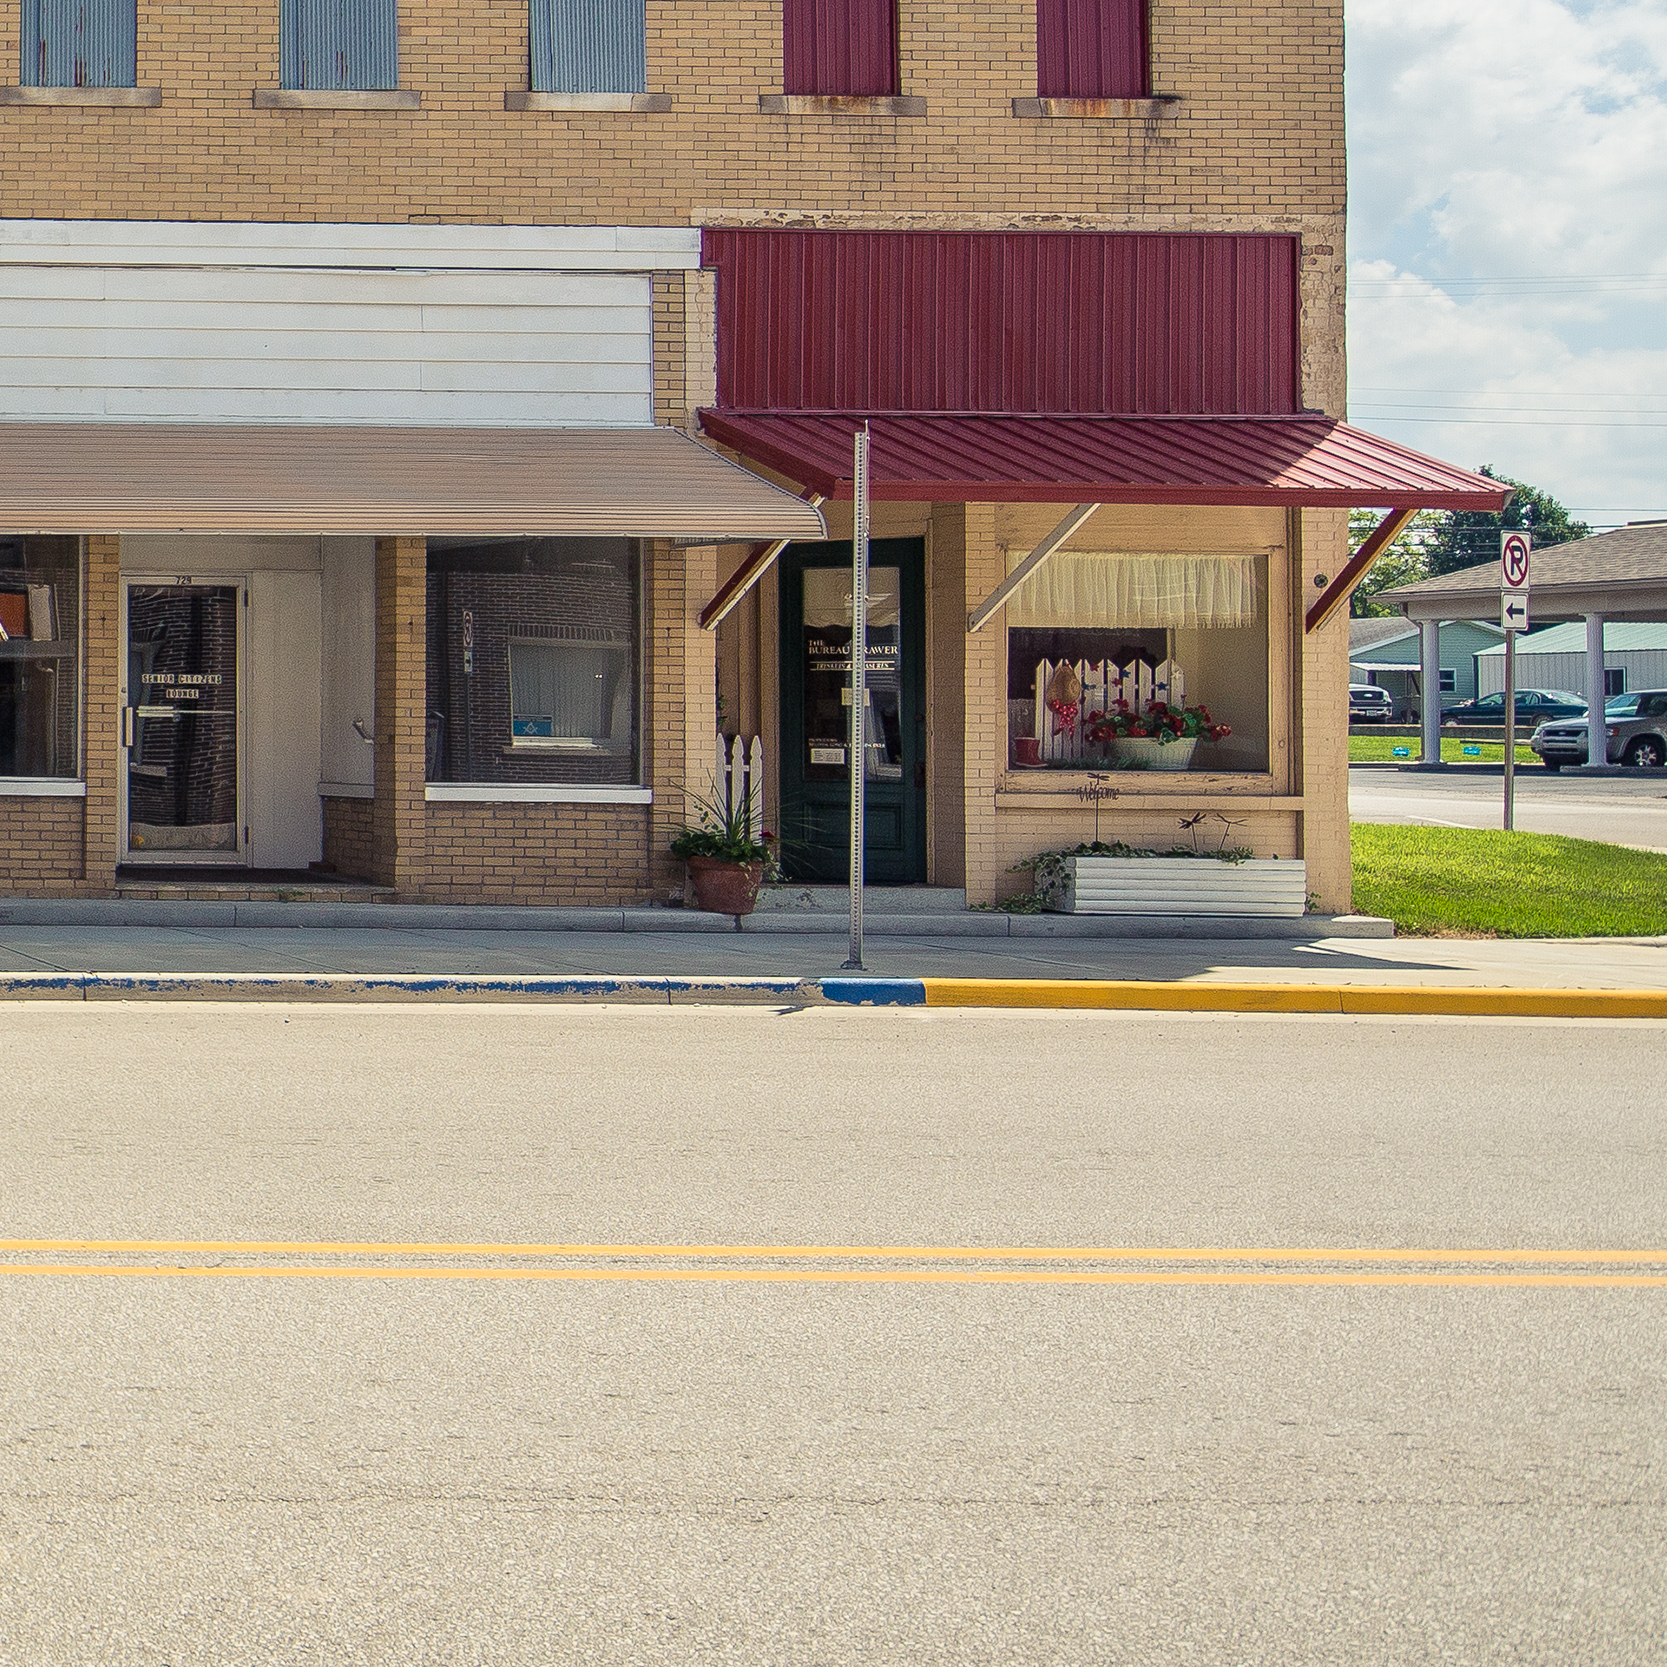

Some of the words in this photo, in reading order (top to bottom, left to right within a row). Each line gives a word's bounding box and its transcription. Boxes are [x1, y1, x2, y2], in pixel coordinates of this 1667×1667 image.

[808, 646, 850, 654] BUREAU
[863, 646, 898, 654] RAWER
[142, 674, 175, 683] SENIOR
[178, 675, 222, 684] CITIZENS
[166, 690, 199, 699] LOUNGE
